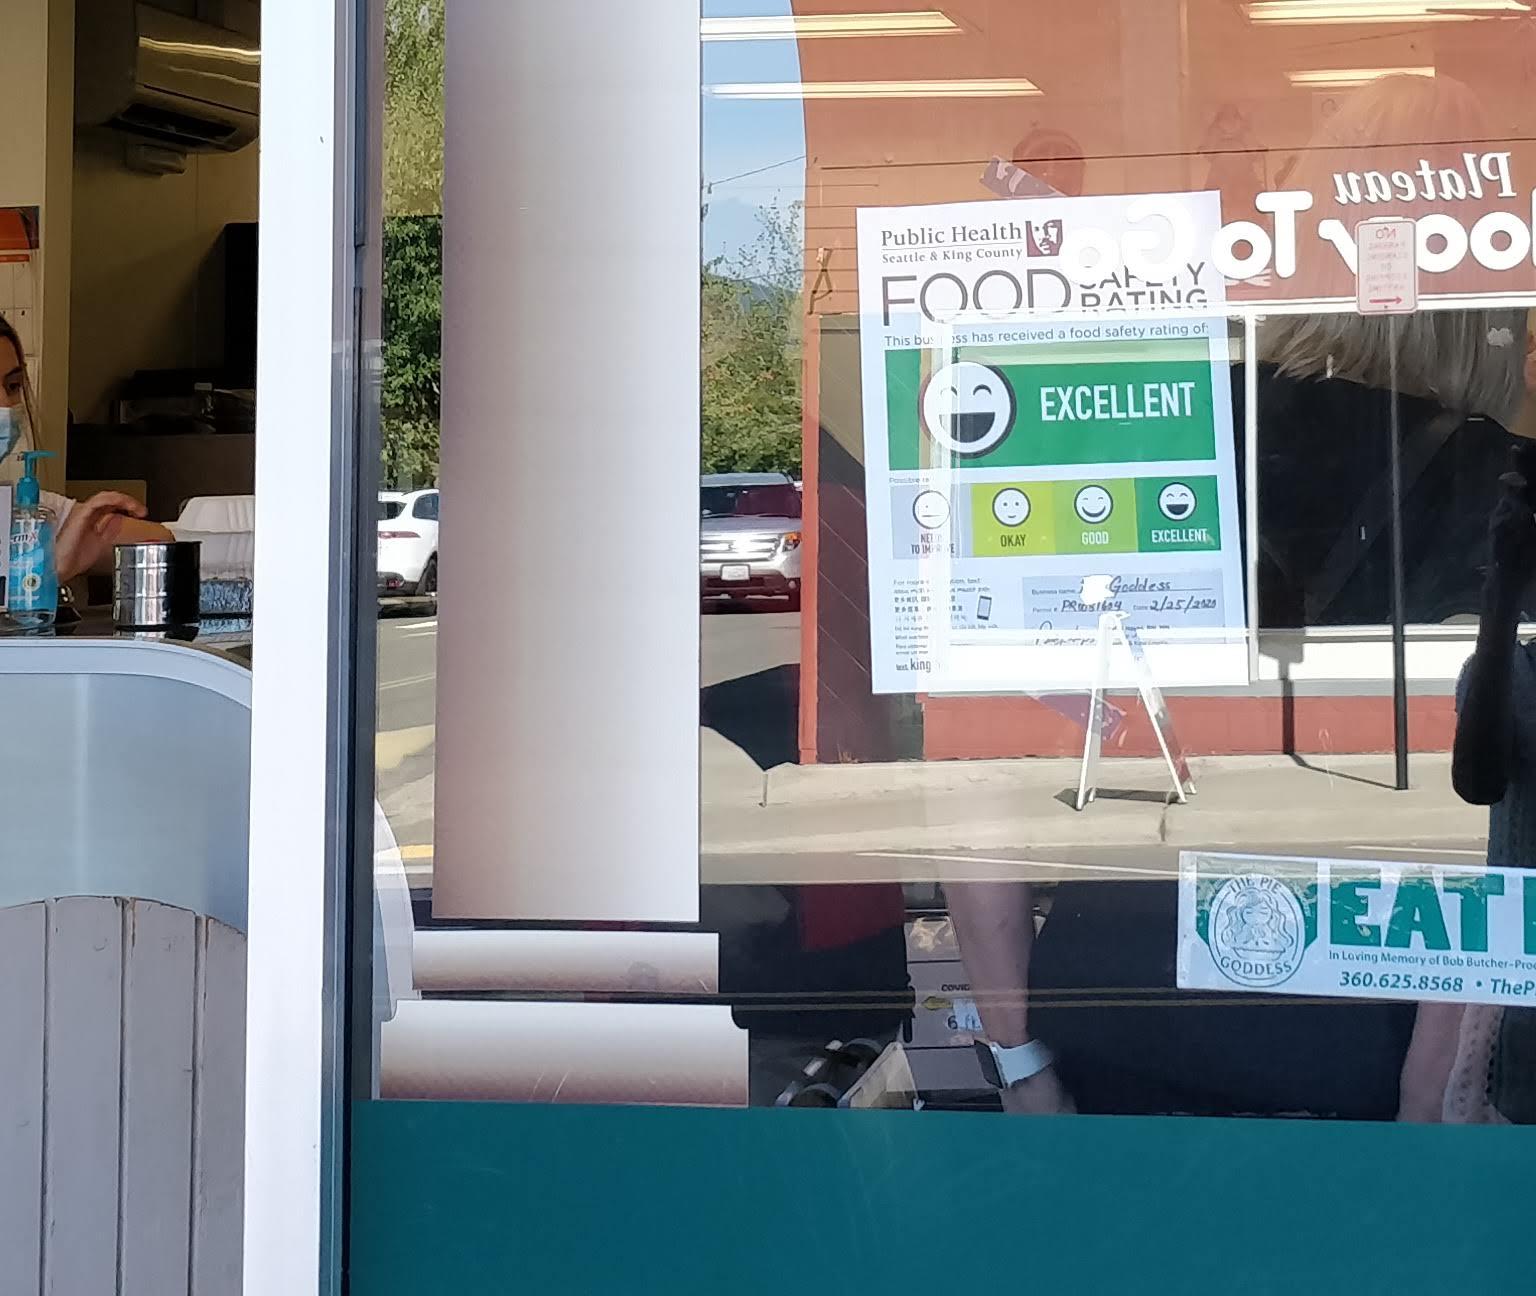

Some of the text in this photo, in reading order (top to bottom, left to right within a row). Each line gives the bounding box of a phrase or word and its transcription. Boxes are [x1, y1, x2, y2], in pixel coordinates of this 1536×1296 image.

[881, 222, 1023, 247] Public Health
[882, 252, 928, 264] Seattle
[942, 249, 972, 263] King
[976, 247, 1023, 261] County
[882, 268, 1072, 326] FOOD
[1081, 289, 1208, 313] RATING
[884, 334, 911, 347] This
[972, 330, 994, 344] has
[998, 328, 1054, 343] received
[1069, 325, 1101, 339] food
[1105, 324, 1146, 340] safety
[1150, 323, 1189, 340] rating
[1040, 381, 1195, 422] EXCELLENT
[1000, 533, 1026, 548] OKAY
[1081, 531, 1109, 546] GOOD
[1151, 528, 1208, 544] EXCELLENT
[1228, 875, 1283, 895] THE PIE
[1329, 866, 1505, 953] EAT
[1220, 954, 1293, 977] GODDESS
[1329, 951, 1340, 961] In
[1342, 951, 1378, 964] Loving
[1381, 953, 1426, 967] Memory
[1428, 955, 1440, 965] of
[1443, 955, 1465, 967] Bob
[1339, 971, 1464, 993] 360.625.8568
